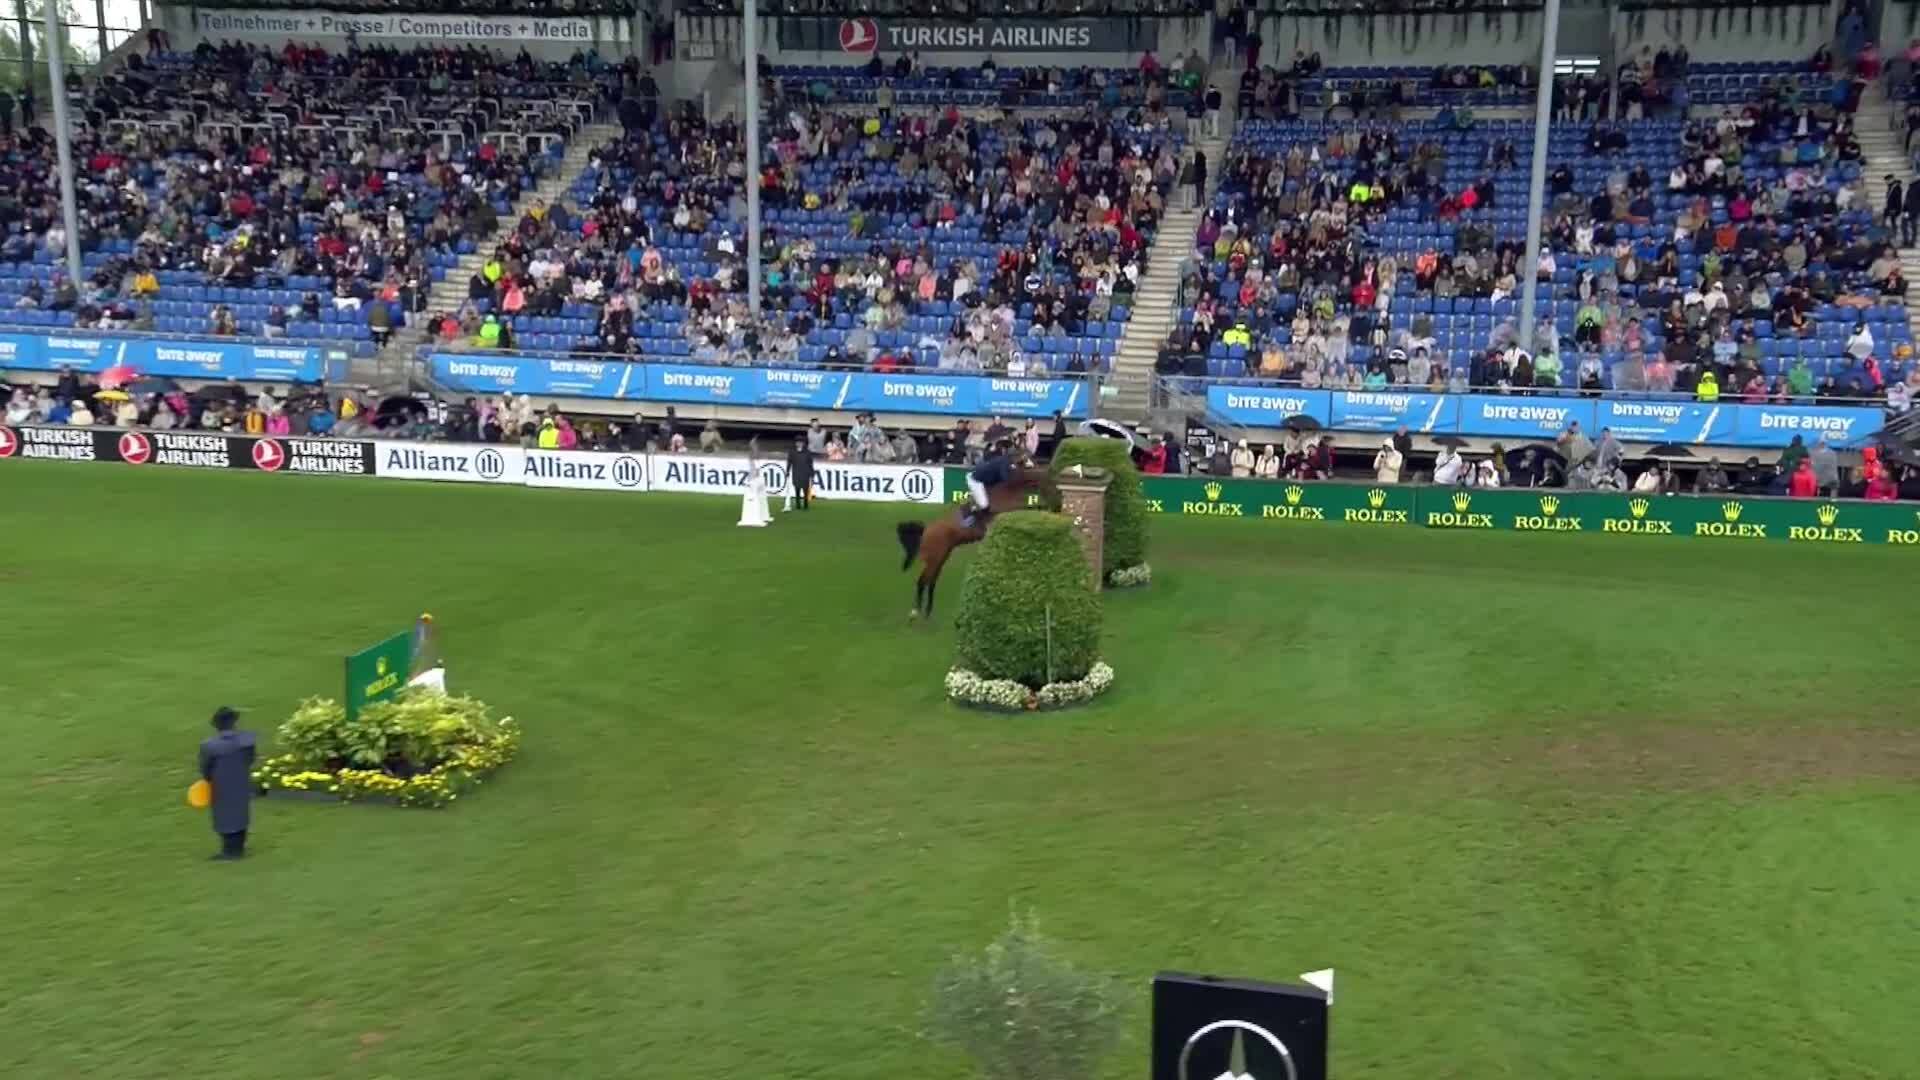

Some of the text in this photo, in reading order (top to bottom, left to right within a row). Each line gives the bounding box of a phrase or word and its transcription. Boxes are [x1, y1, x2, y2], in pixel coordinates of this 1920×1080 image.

[202, 14, 299, 32] Teilnehmer
[306, 19, 315, 29] +
[321, 16, 384, 33] Presse
[399, 18, 512, 39] Competitors
[518, 24, 529, 34] +
[533, 22, 588, 38] Media
[888, 26, 1091, 47] TURKISH AIRLINES
[915, 383, 958, 398] away
[1262, 398, 1307, 411] away
[1376, 394, 1411, 407] away
[1520, 406, 1569, 421] away
[1643, 406, 1683, 417] away
[1801, 416, 1855, 431] away
[20, 428, 94, 445] TURKISH
[153, 434, 227, 451] TURKISH
[21, 444, 96, 461] AIRLINES
[288, 440, 363, 458] TURKISH
[156, 450, 230, 468] AIRLINES
[288, 456, 364, 473] AIRLINES
[387, 449, 469, 473] Allianz
[524, 456, 606, 480] Allianz
[665, 461, 750, 487] Allianz
[812, 469, 895, 493] Allianz
[1183, 501, 1243, 516] ROLEX
[1263, 504, 1324, 520] ROLEX
[1345, 508, 1407, 523] ROLEX
[1428, 512, 1493, 527] ROLEX
[1515, 516, 1582, 530] ROLEX
[1602, 519, 1672, 534] ROLEX
[1695, 522, 1766, 538] ROLEX
[1789, 526, 1863, 542] ROLEX
